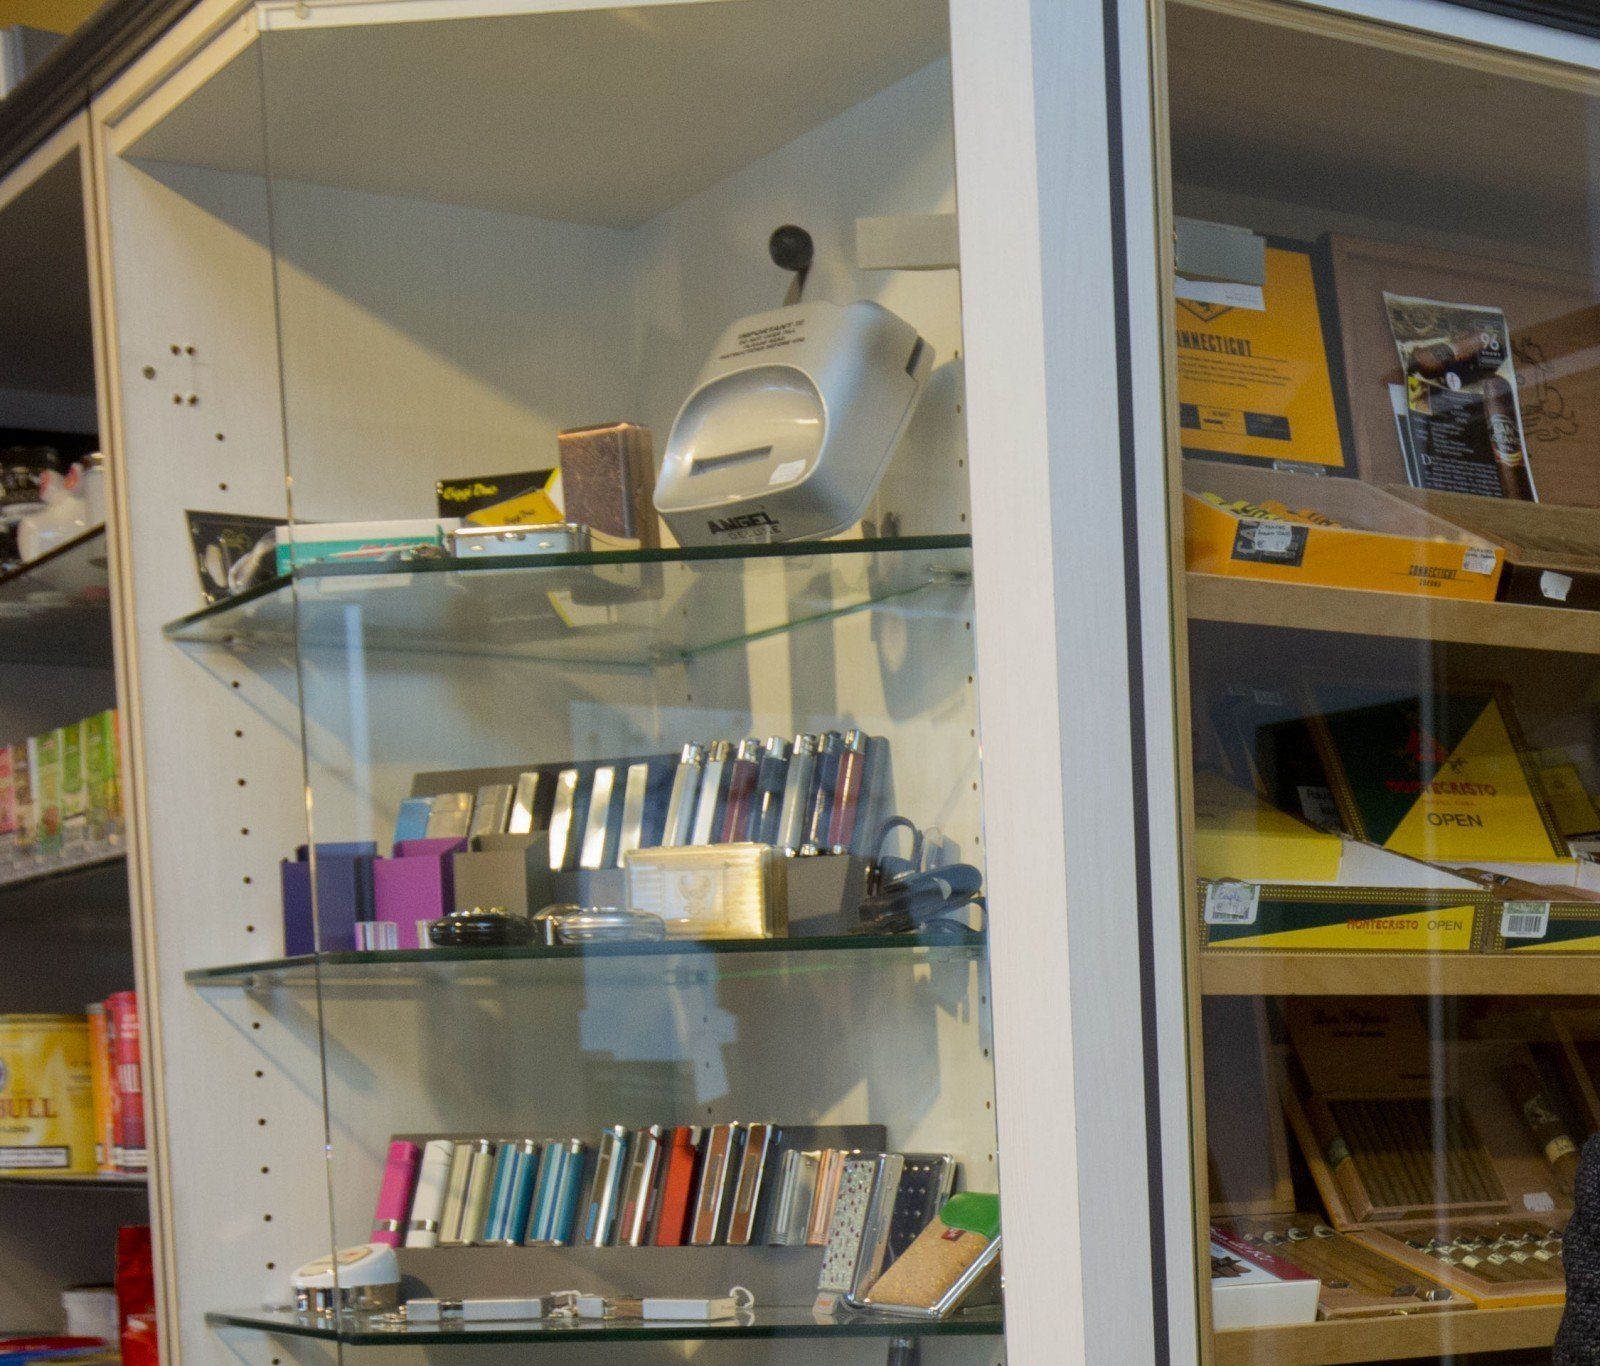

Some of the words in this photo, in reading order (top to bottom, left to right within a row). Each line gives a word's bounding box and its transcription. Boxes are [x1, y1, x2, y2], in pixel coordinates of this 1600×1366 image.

[1480, 332, 1500, 350] 96
[707, 511, 780, 535] ANGEL
[1428, 812, 1484, 828] OPEN
[1346, 919, 1419, 933] MONTECRISTO
[1427, 920, 1464, 932] OPEN
